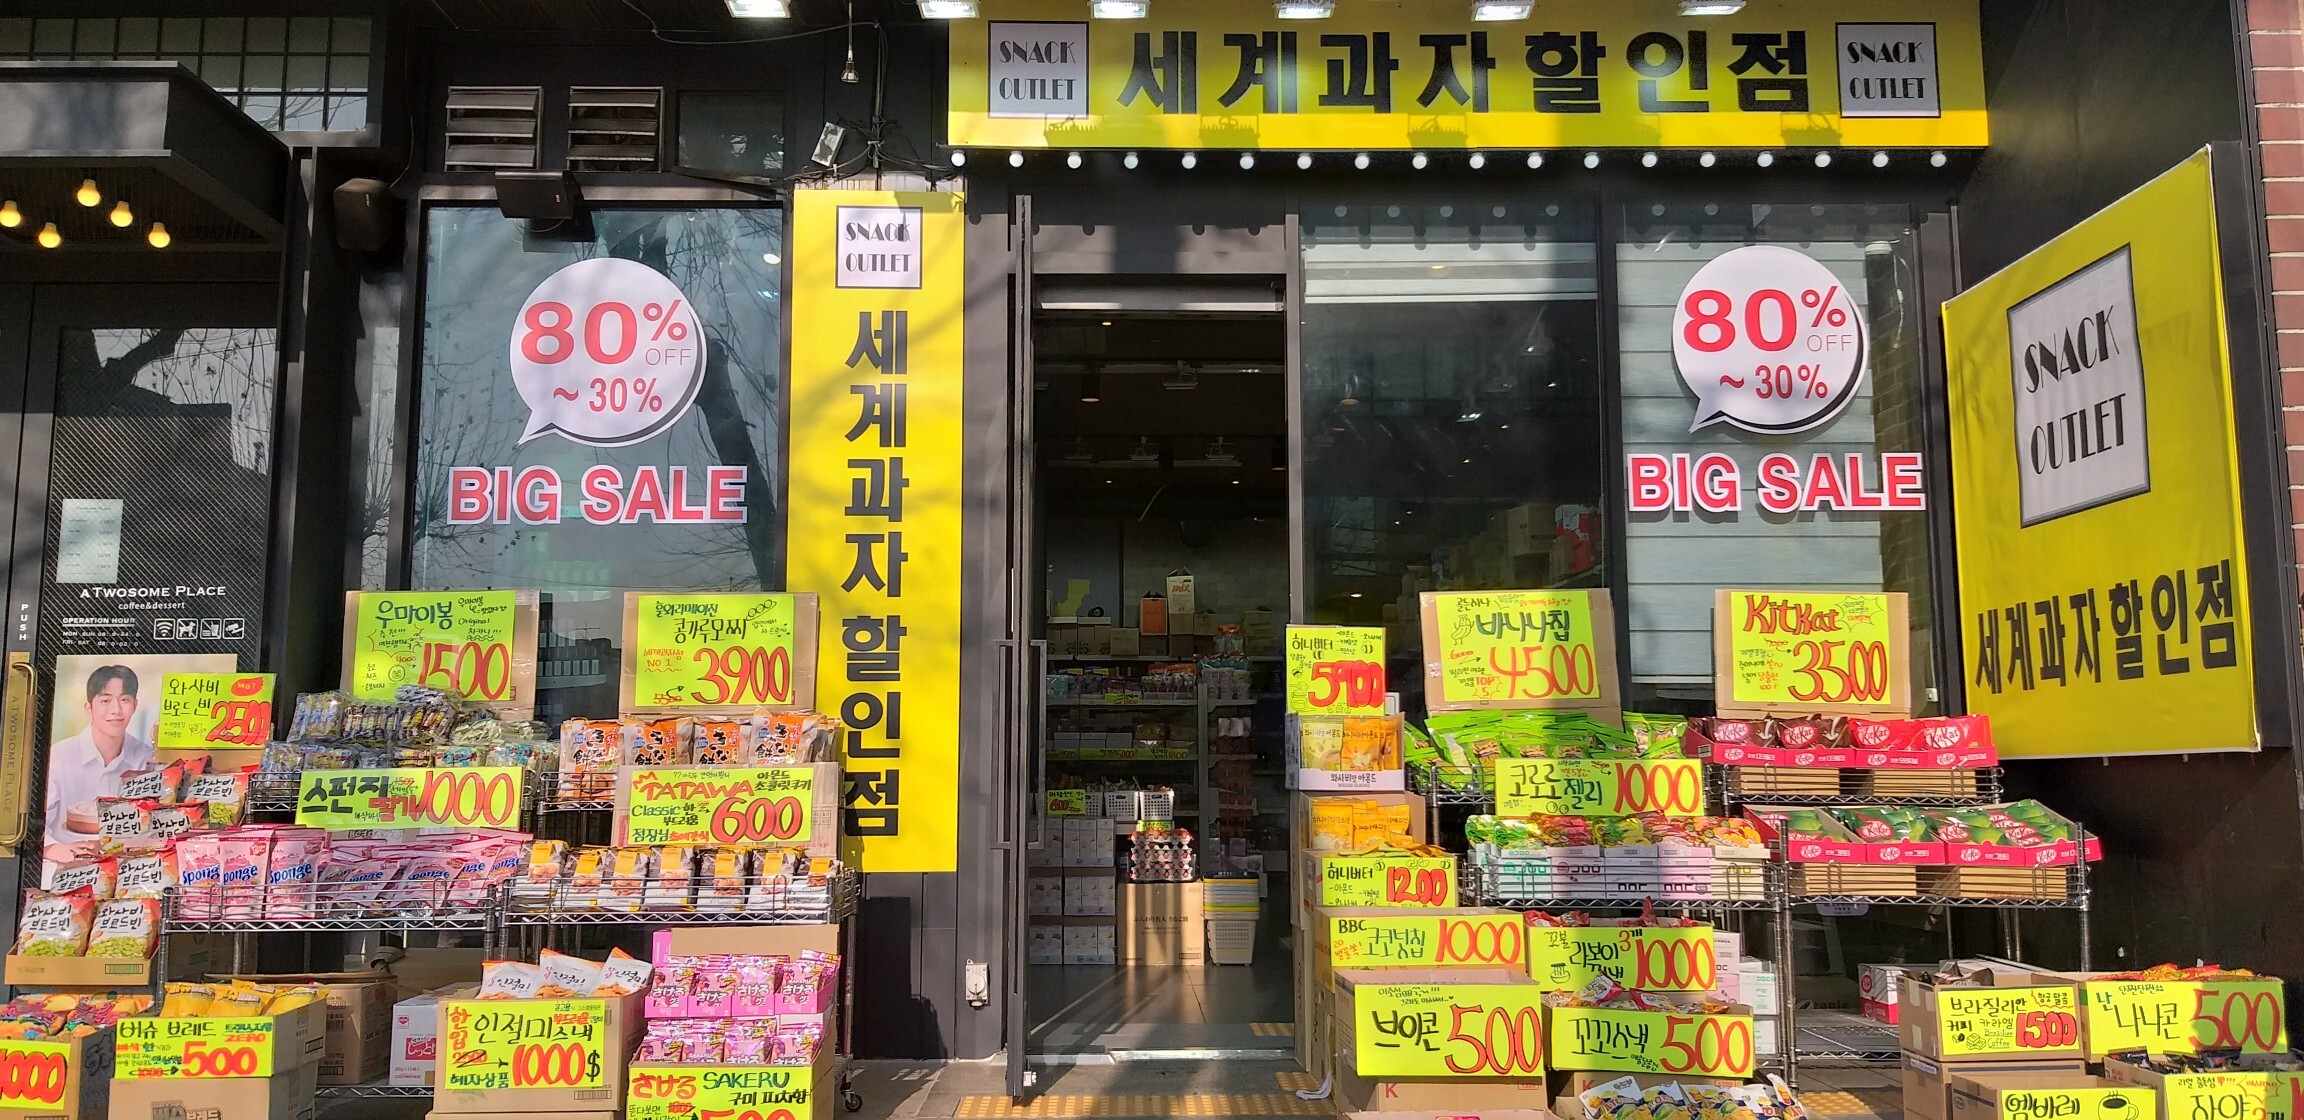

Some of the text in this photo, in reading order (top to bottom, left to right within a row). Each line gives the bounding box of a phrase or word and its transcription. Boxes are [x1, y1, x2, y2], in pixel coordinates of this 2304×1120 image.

[999, 40, 1076, 65] SNACK
[1847, 40, 1924, 64] SNACK
[999, 77, 1077, 101] OUTLET
[1849, 77, 1927, 101] OUTLET
[845, 219, 912, 243] SNACK
[845, 252, 911, 273] OUTLET
[1683, 286, 1846, 352] 80%
[520, 298, 689, 365] 80%
[1806, 334, 1853, 352] OFF
[2024, 303, 2121, 394] SNACK
[644, 347, 692, 367] OFF
[2030, 393, 2127, 476] OUTLET
[1628, 452, 1927, 513] BIG SALE
[448, 464, 748, 525] BIG SALE
[79, 585, 226, 599] A TWOSOME PLACE
[118, 601, 186, 610] coffee&dessert
[375, 600, 454, 631] 우마이봉
[1743, 594, 1843, 635] KitKat
[19, 603, 29, 641] PUSH
[62, 617, 109, 625] OPERATION
[1475, 609, 1571, 642] 바나나칩
[1292, 632, 1333, 651] 허니버터
[418, 642, 510, 700] 1500
[690, 645, 790, 705] 3900
[1475, 676, 1495, 686] TOP
[1489, 643, 1594, 699] 4500
[1787, 640, 1887, 702] 3500
[169, 678, 220, 696] 와사비
[1308, 659, 1385, 708] 5900
[1481, 686, 1490, 697] 5
[205, 700, 271, 746] 2500
[1720, 724, 1746, 740] KitKat
[7, 704, 20, 769] TWOSOME
[1787, 725, 1812, 743] KitKat
[1862, 724, 1889, 745] KitKat
[1927, 726, 1960, 748] KitKat
[123, 772, 163, 790] 와사비
[193, 777, 236, 788] 와사비
[757, 769, 791, 780] 아몬드
[1358, 773, 1377, 783] 아몬드
[1508, 763, 1562, 799] 코로로
[4, 773, 15, 814] PLACE
[302, 776, 390, 814] 스펀지
[414, 771, 514, 825] 1000
[639, 779, 755, 801] TATAWA
[1563, 778, 1603, 810] 젤리
[1613, 762, 1700, 814] 1000
[101, 808, 140, 823] 와사비
[631, 803, 681, 818] Classic
[710, 796, 803, 843] 600
[152, 815, 190, 830] 와사비
[632, 828, 670, 843] 점장님
[55, 866, 101, 885] 와사비
[118, 859, 162, 877] 와사비
[122, 870, 163, 887] 브로드빈
[223, 865, 258, 885] ponge
[1327, 862, 1373, 880] 허니버터
[56, 875, 99, 891] 브로드빈
[1386, 866, 1448, 906] 1200
[27, 903, 73, 919] 와사비
[99, 905, 145, 918] 와사비
[28, 915, 72, 931] 브로드빈
[100, 915, 143, 930] 브로드빈
[1338, 919, 1426, 960] BBC 코코넛칩
[1434, 918, 1521, 964] 1000
[1635, 938, 1716, 990] 1000
[496, 977, 532, 991] 인절미
[553, 971, 586, 986] 인절미
[615, 970, 647, 985] 인절미
[652, 986, 685, 998] さける
[737, 984, 769, 996] さける
[782, 984, 814, 996] さける
[1950, 997, 2028, 1018] 브라질리안
[2095, 991, 2114, 1012] 난
[119, 1020, 217, 1040] 버슈 브레드
[448, 1006, 473, 1051] 한입
[1947, 1019, 1973, 1032] 커피
[2015, 1010, 2078, 1048] 1500
[2113, 1003, 2181, 1040] 나나콘
[2188, 988, 2281, 1051] 500
[224, 1033, 267, 1043] ZERO
[1371, 1010, 1441, 1052] 브이콘
[1444, 1004, 1543, 1075] 500
[1568, 1017, 1649, 1060] 꼬꼬스낵
[1659, 1015, 1751, 1074] 500
[181, 1041, 258, 1077] 500
[631, 1072, 697, 1100] さける
[702, 1071, 790, 1090] SAKERU
[1384, 1083, 1399, 1099] K
[727, 1091, 757, 1107] 구미
